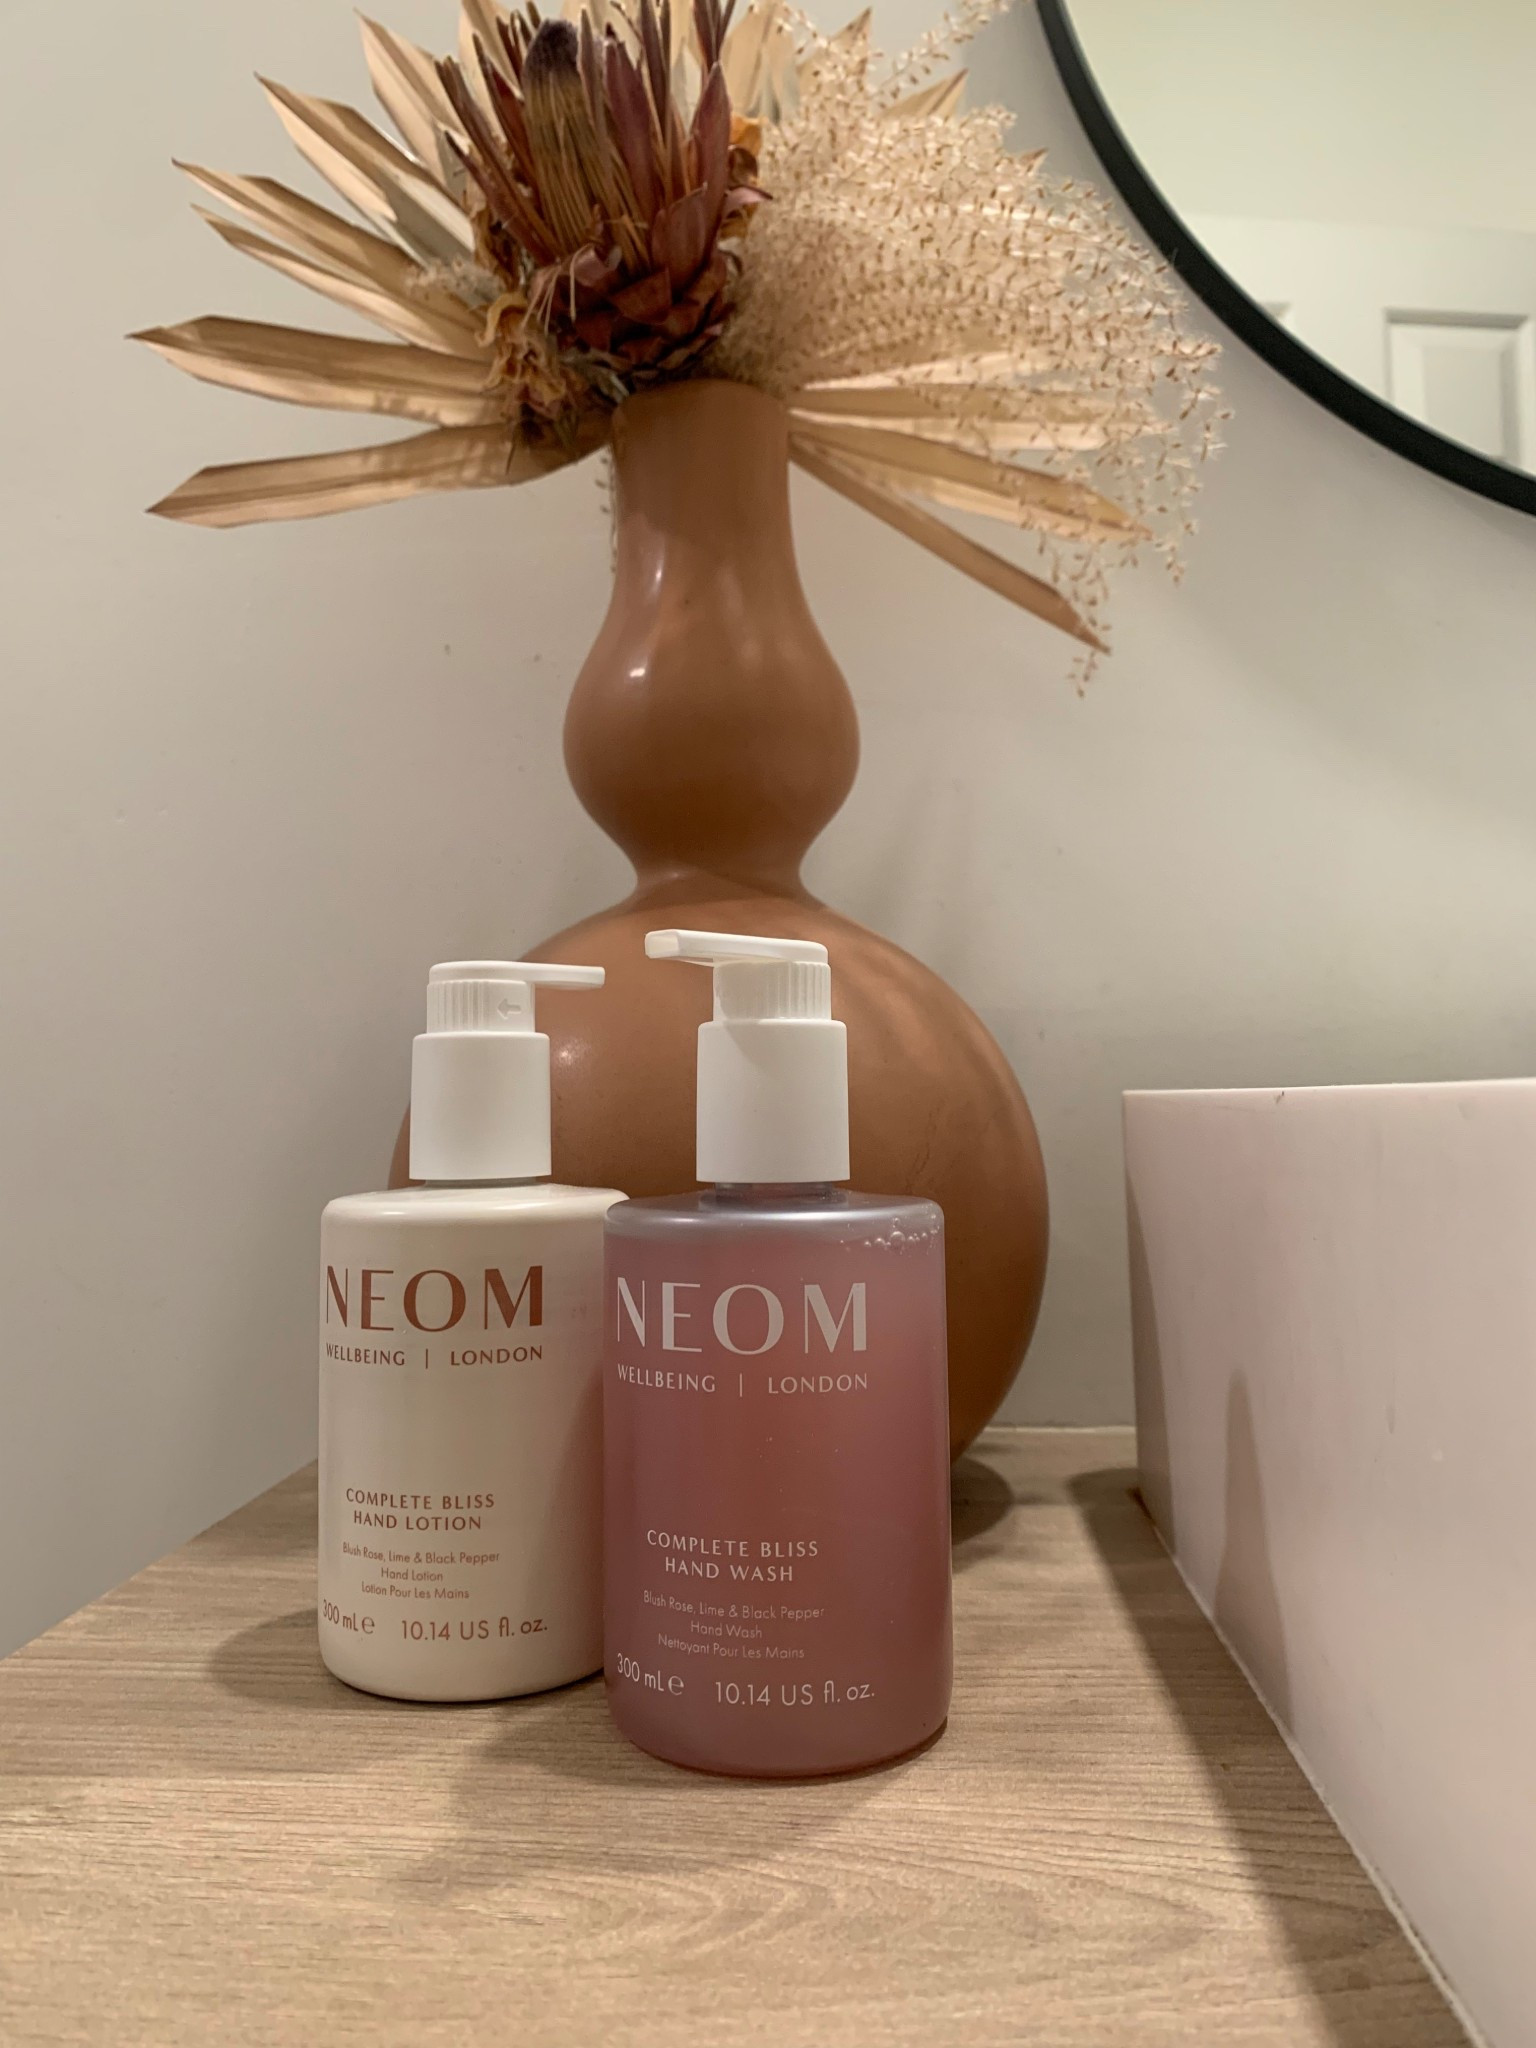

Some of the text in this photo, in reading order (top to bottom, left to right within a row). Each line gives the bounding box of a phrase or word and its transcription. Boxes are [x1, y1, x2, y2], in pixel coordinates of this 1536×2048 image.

[326, 1265, 543, 1333] NEOM
[617, 1276, 867, 1355] NEOM
[326, 1342, 405, 1366] WELLBEING
[450, 1345, 543, 1366] LONDON
[617, 1363, 716, 1393] WELLBEING
[768, 1373, 867, 1394] LONDON
[346, 1488, 495, 1510] COMPLETE BLISS
[354, 1510, 481, 1531] HAND LOTION
[342, 1542, 500, 1565] Blush Rose, Lime & Black Pepper
[647, 1530, 818, 1558] COMPLETE BLISS
[380, 1567, 443, 1582] Hand Lotion
[665, 1557, 793, 1582] HAND WASH
[362, 1583, 469, 1599] Lotion Pour Les Mains
[323, 1598, 339, 1624] 300
[643, 1590, 825, 1621] Blush Rose, Lime & Black Pepper
[402, 1616, 548, 1641] 10.14 US fl. oz.
[690, 1621, 762, 1639] Hand Wash
[658, 1633, 805, 1659] Nettoyant Pour Les Mains
[617, 1652, 640, 1682] 300
[716, 1680, 875, 1706] 10.14 US fl. oz.
